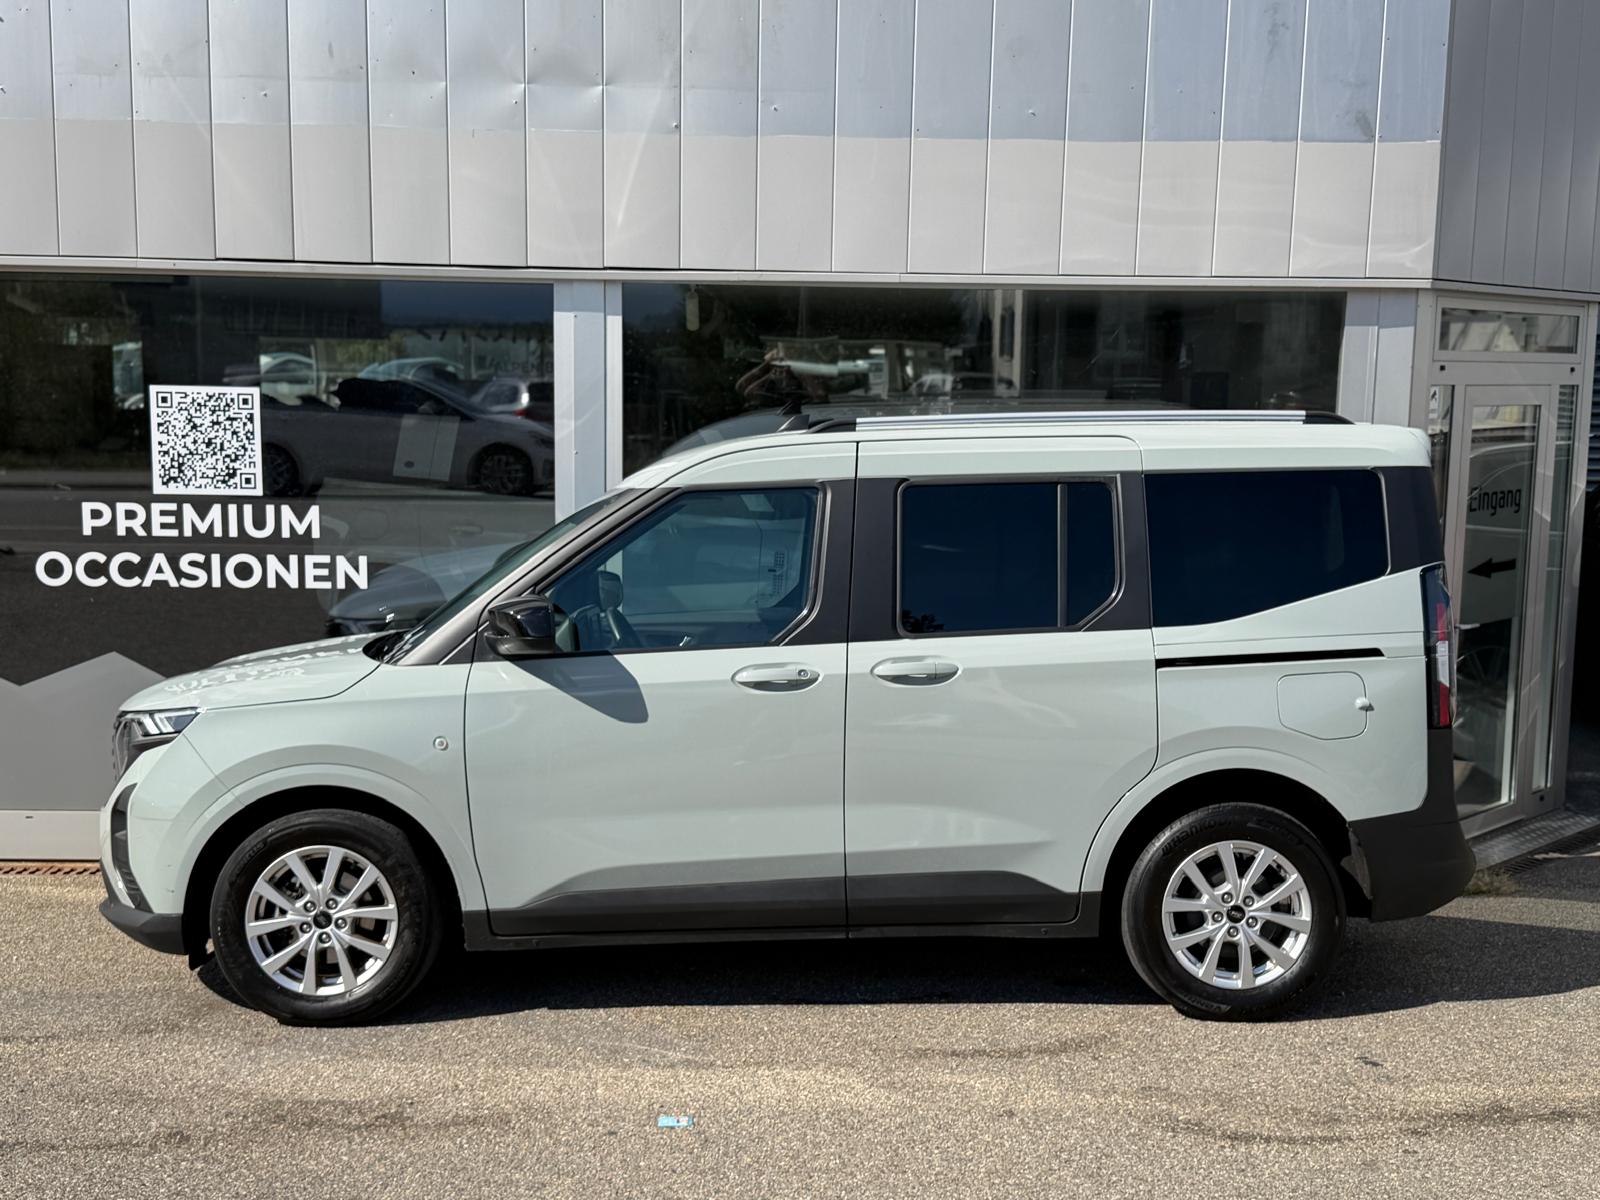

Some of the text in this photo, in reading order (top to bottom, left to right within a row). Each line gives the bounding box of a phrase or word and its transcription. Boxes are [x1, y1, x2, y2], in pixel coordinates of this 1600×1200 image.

[81, 501, 321, 539] PREMIUM
[1469, 486, 1522, 516] Eingang
[34, 550, 369, 590] OCCASIONEN
